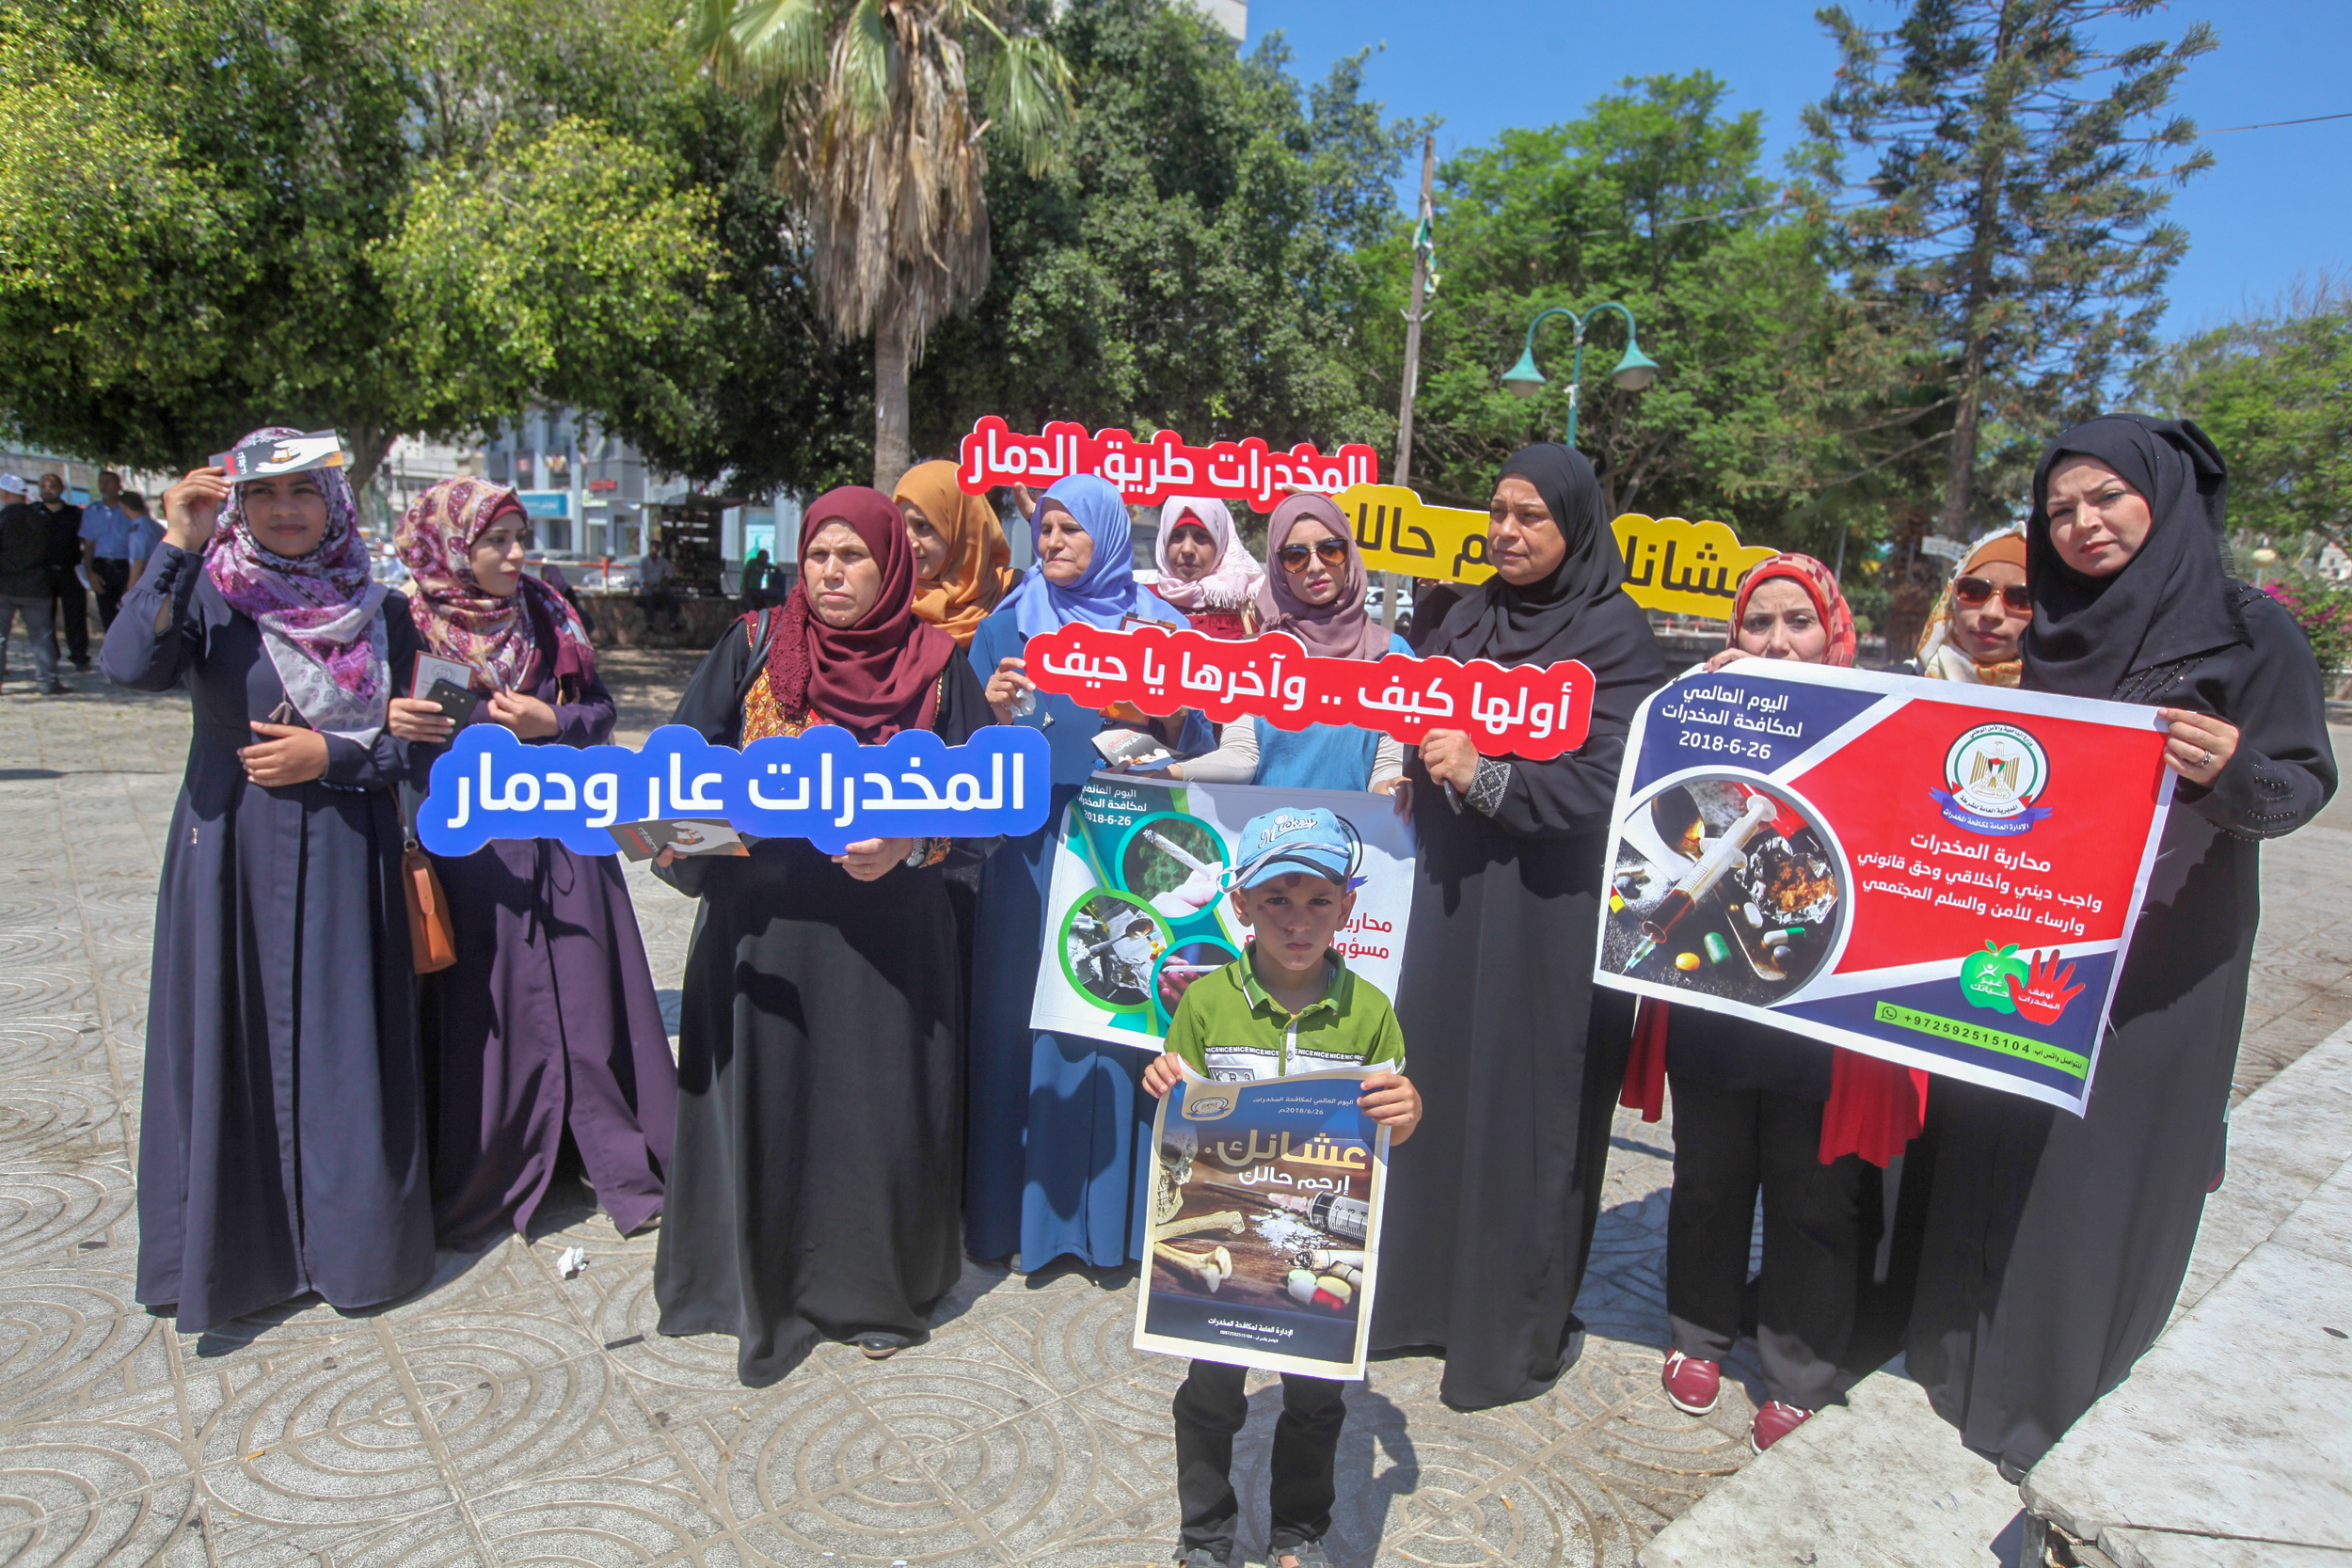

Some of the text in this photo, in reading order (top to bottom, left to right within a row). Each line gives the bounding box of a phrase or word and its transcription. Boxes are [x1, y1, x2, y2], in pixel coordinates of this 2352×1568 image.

[967, 429, 1367, 501] المخدرات طريق الدمار
[1625, 535, 1747, 599] شان
[1042, 641, 1128, 689] حيف
[1142, 647, 1166, 696] يا
[1181, 651, 1307, 711] وآخرها
[1358, 675, 1454, 724] كيف
[1470, 681, 1572, 738] أولها
[1683, 685, 1788, 714] اليوم العالمي
[1661, 704, 1804, 737] لمكافحة المخدرات
[1678, 730, 1772, 760] 2018-6-26
[446, 752, 1025, 828] المخدرات عار ودمار
[1107, 799, 1147, 812] لمكافحة
[1113, 788, 1136, 799] اليوم
[1083, 809, 1132, 826] 2018-6-26
[1910, 833, 2052, 872] محاربة المخدرات
[1857, 852, 2104, 913] واجب ديني وأخلاقي وحق قانوني
[1343, 912, 1392, 934] محارب
[1862, 879, 2086, 936] وارساء للأمن والسلم المجتمعي
[1970, 983, 2010, 998] حياتك
[1979, 975, 2003, 987] غير
[2027, 988, 2054, 1000] أوقف
[2018, 994, 2060, 1010] المخدرات
[1238, 1164, 1350, 1196] إرحم حالك
[1207, 1317, 1234, 1326] المخدرات
[1234, 1321, 1258, 1331] لمكافحة
[1258, 1323, 1275, 1333] العامة
